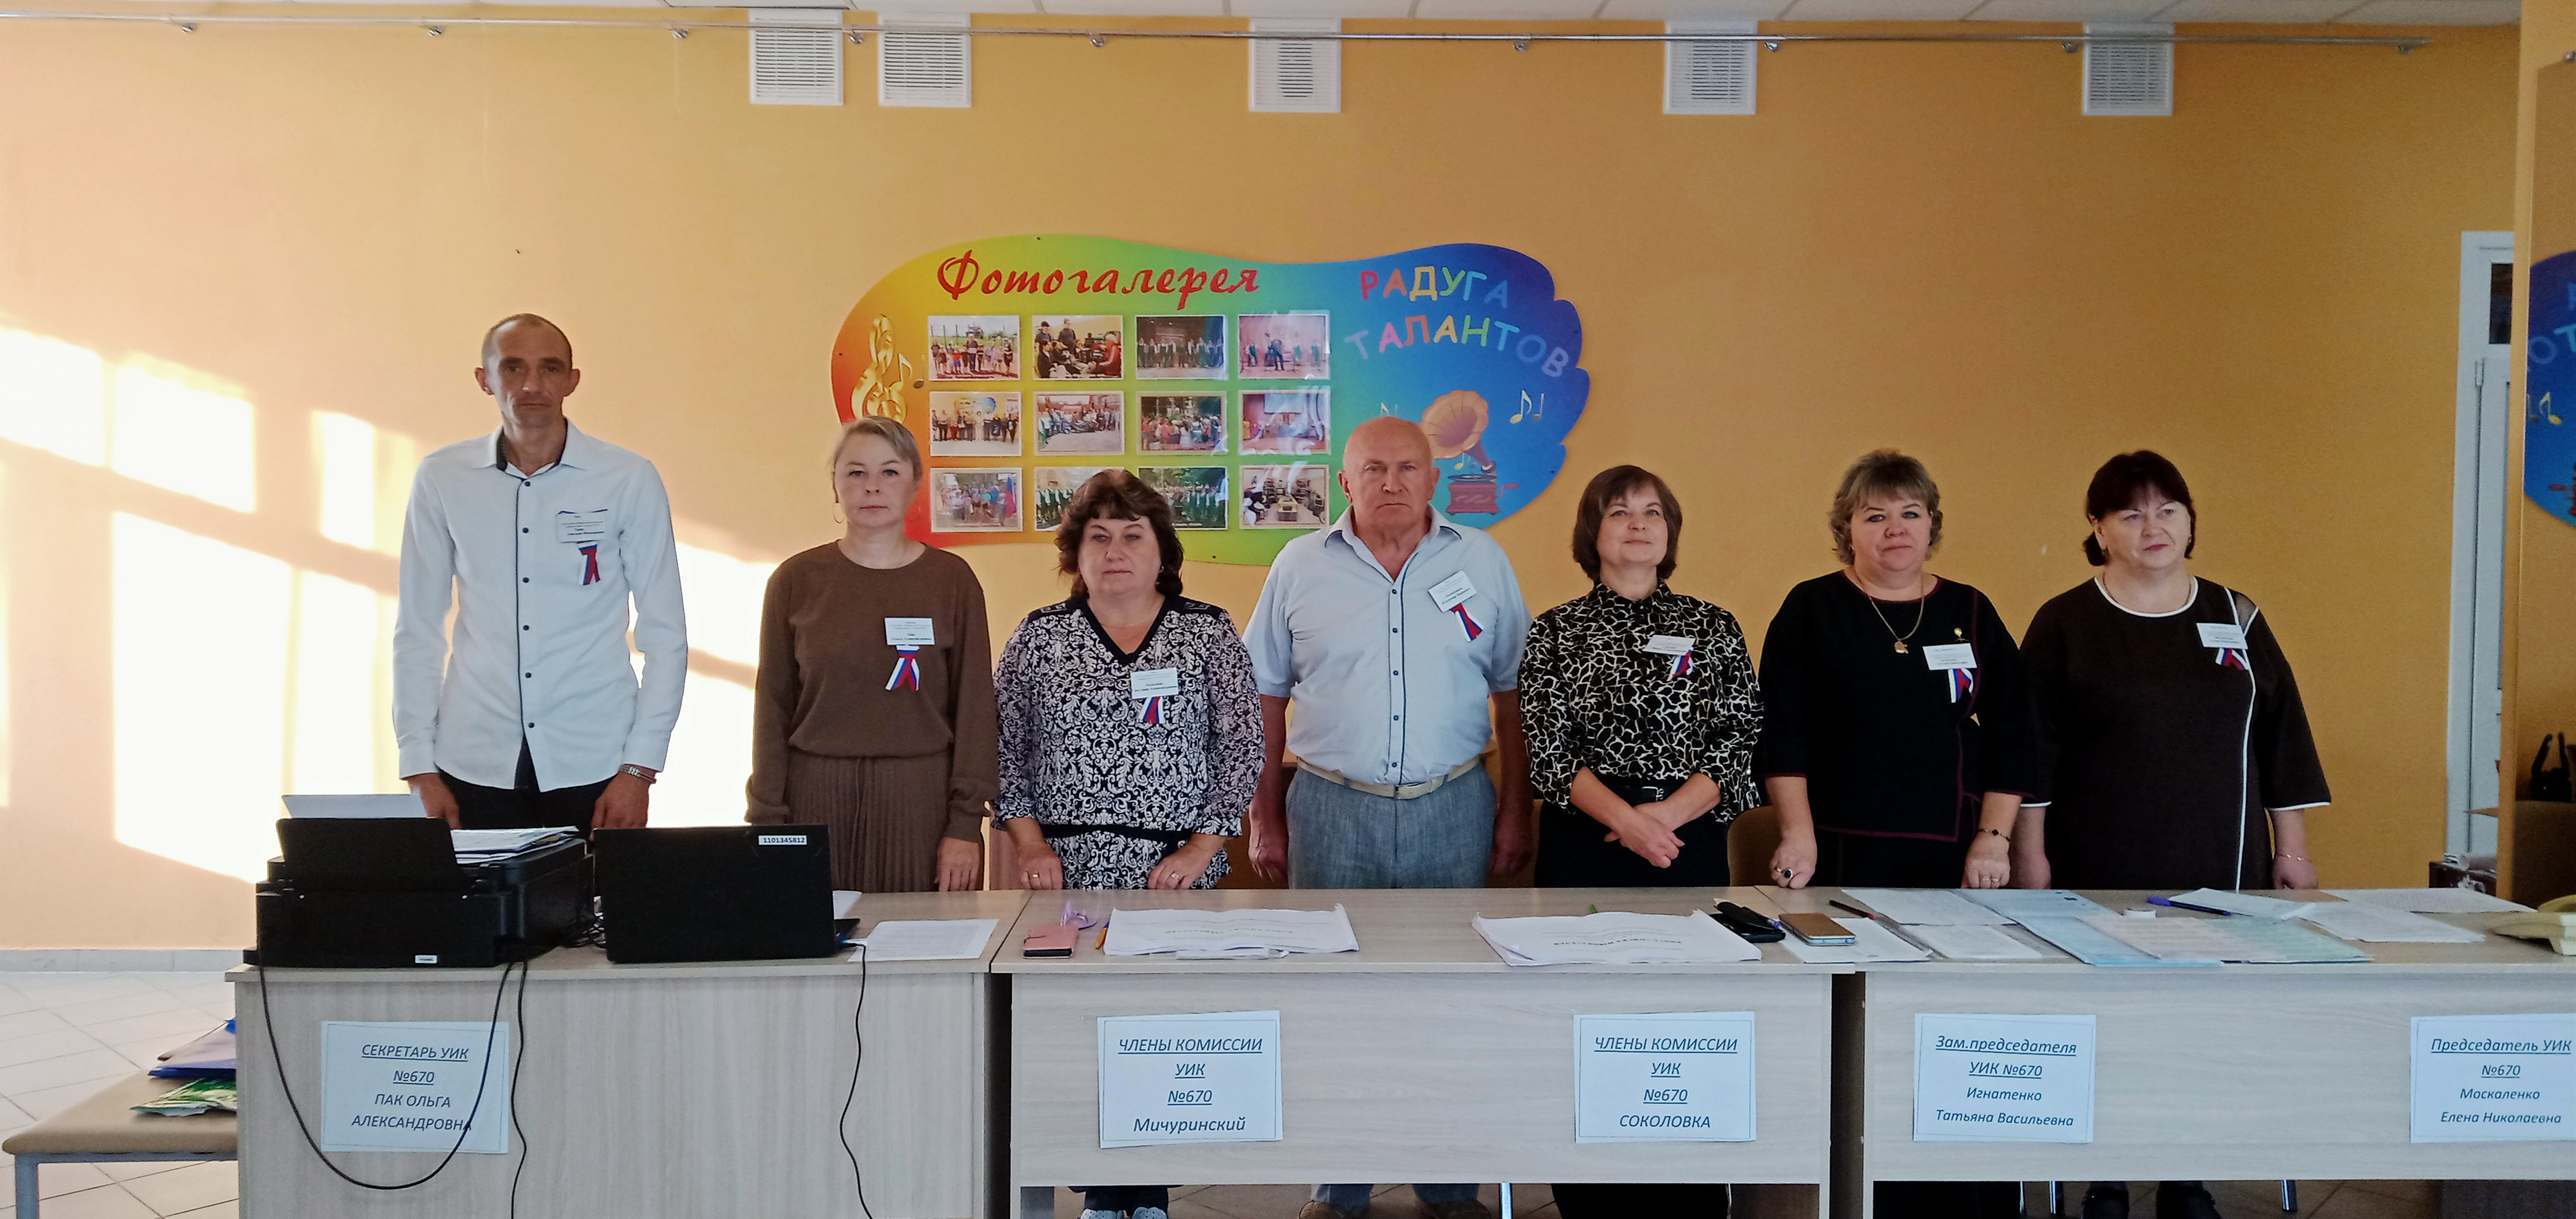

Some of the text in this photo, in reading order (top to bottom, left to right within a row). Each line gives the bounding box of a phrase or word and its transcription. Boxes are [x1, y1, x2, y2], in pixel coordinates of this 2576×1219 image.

[937, 250, 1259, 310] Фотогалерея
[1360, 266, 1508, 308] РАДУГА
[1344, 314, 1569, 377] ТАЛАНТОВ
[1120, 1038, 1263, 1052] ЧЛЕНЫ КОМИССИИ
[1595, 1037, 1738, 1051] ЧЛЕНЫ КОМИССИИ
[1936, 1035, 2077, 1054] Зам.председателя
[2431, 1038, 2572, 1053] Председатель УИК
[362, 1044, 469, 1059] СЕКРЕТАРЬ УИК
[1175, 1064, 1205, 1076] УИК
[1651, 1062, 1681, 1075] УИК
[1969, 1062, 2042, 1077] УИК №670
[2481, 1065, 2521, 1077] №670
[393, 1070, 435, 1083] №670
[375, 1093, 451, 1108] ПАК ОЛЬГА
[1168, 1090, 1212, 1103] №670
[1643, 1089, 1688, 1101] №670
[1967, 1087, 2042, 1101] Игнатенко
[2460, 1088, 2540, 1099] Москаленко
[1619, 1115, 1710, 1128] СОКОЛОВКА
[1936, 1109, 2074, 1126] Татьяна Васильевна
[2440, 1111, 2562, 1124] Елена Николаевна
[1134, 1116, 1245, 1134] Мичуринский
